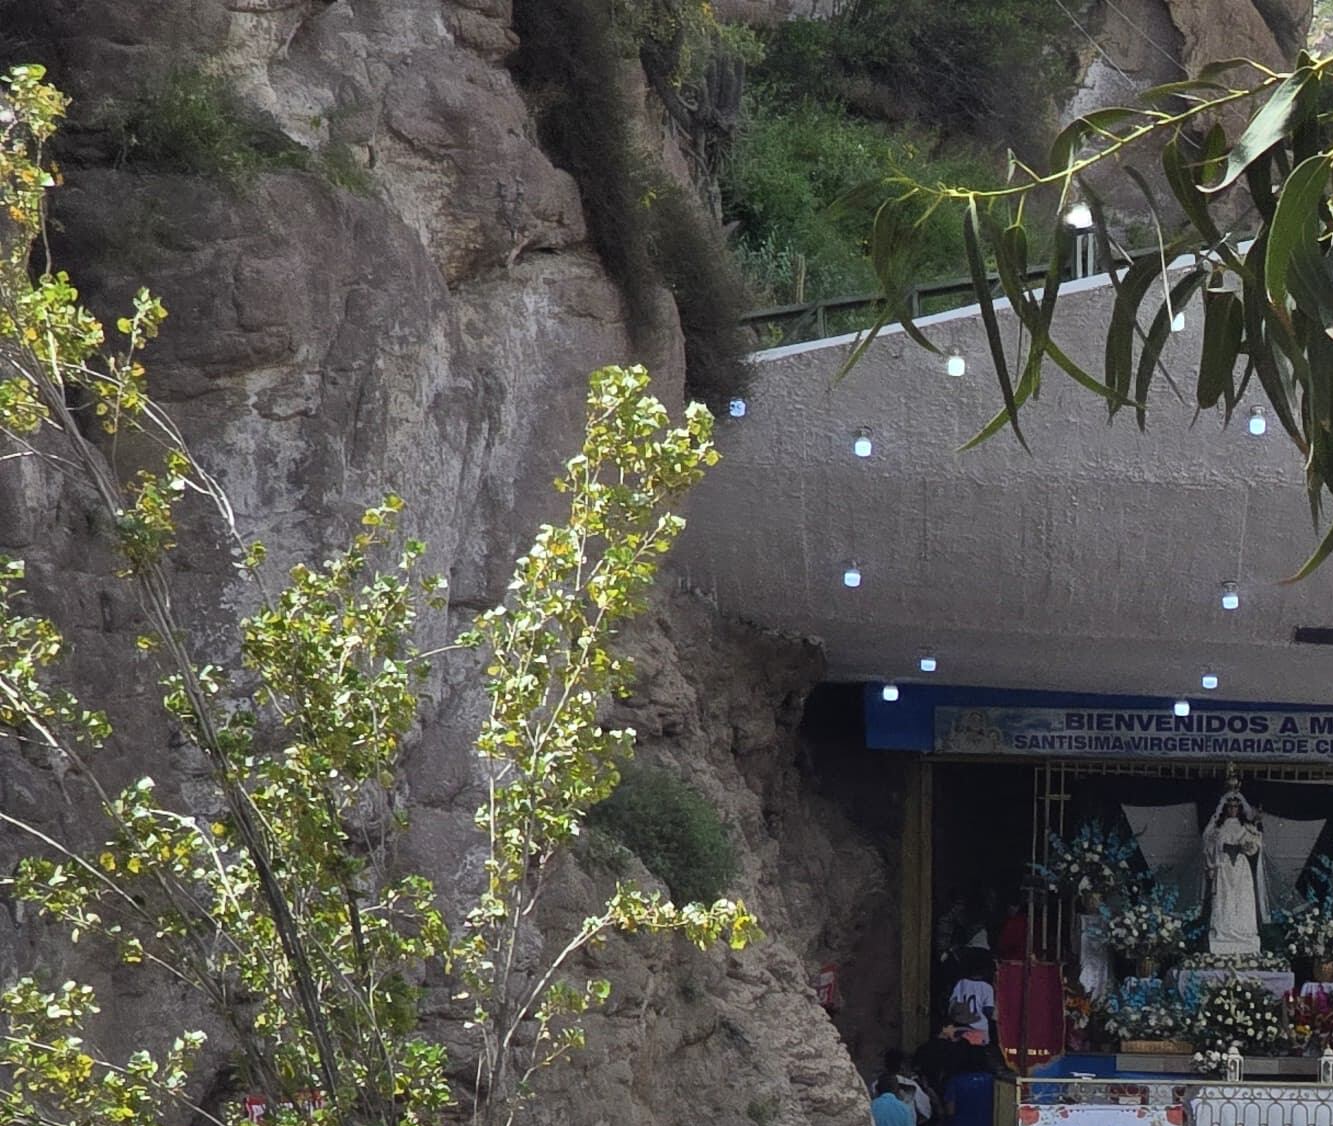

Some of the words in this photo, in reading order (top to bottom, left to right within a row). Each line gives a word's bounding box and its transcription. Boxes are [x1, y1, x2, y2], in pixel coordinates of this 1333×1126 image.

[1064, 712, 1269, 734] BIENVENIDOS
[1279, 716, 1299, 735] A
[1014, 734, 1127, 751] SANTISIMA
[1129, 736, 1201, 753] VIRGEN
[1212, 738, 1273, 753] MARIA
[1282, 739, 1308, 754] DE
